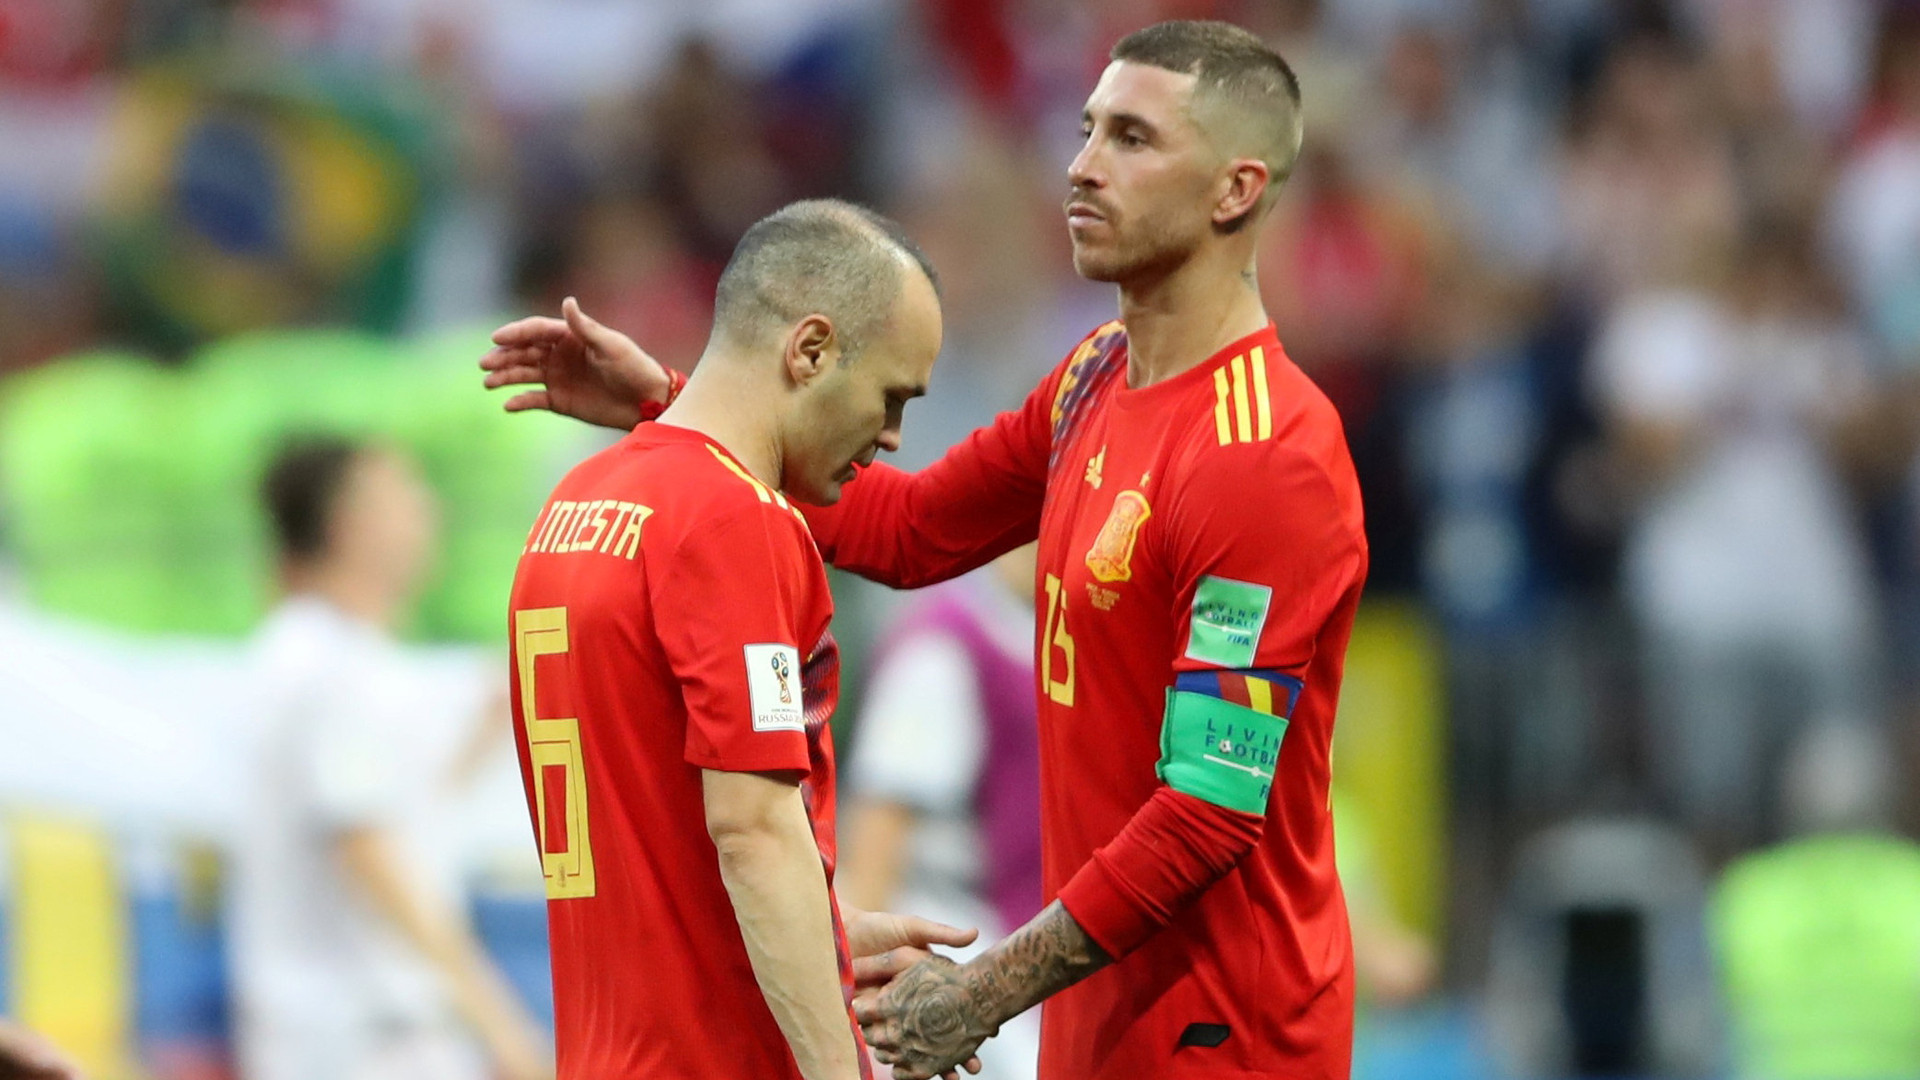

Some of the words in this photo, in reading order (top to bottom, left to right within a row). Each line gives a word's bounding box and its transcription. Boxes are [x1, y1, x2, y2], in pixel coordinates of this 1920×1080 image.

[529, 499, 655, 560] INIESTA
[1041, 571, 1076, 708] 15
[515, 606, 596, 900] 6
[1204, 733, 1276, 767] FOOTBA
[1206, 718, 1280, 750] LIVIN
